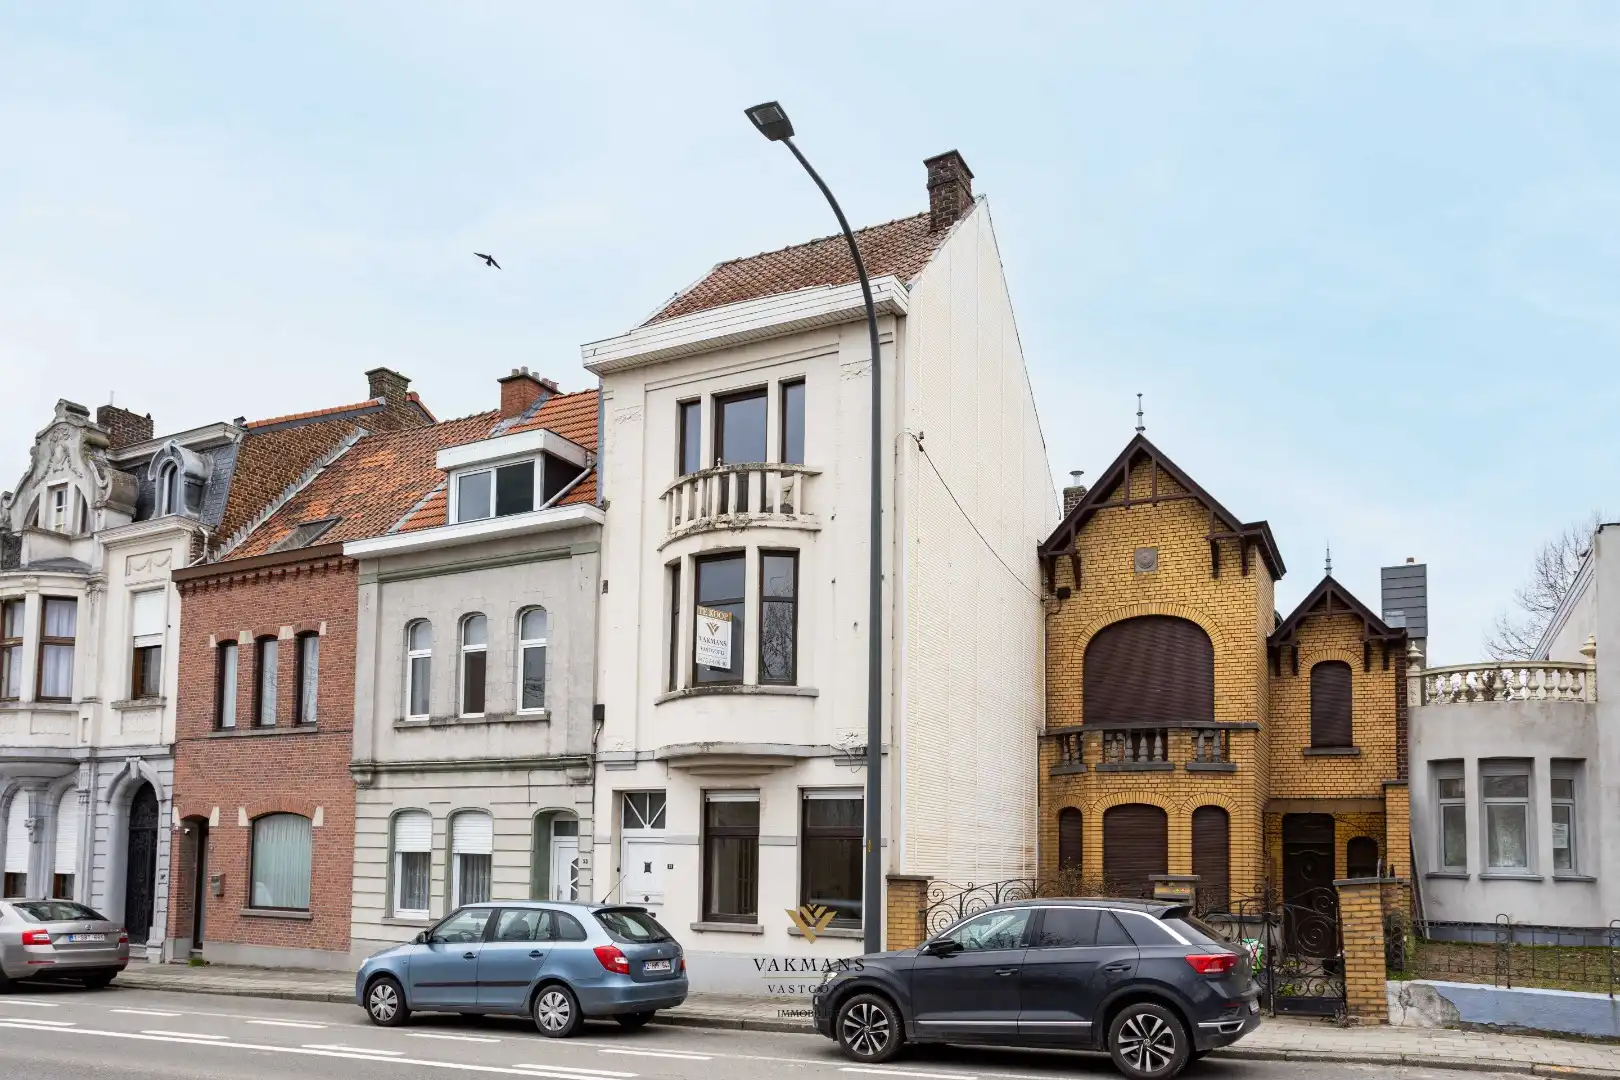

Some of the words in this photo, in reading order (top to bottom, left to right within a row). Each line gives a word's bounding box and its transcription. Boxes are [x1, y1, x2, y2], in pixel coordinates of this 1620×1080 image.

[698, 606, 708, 616] TE
[708, 609, 729, 620] KOOP
[698, 636, 728, 647] VAKMANS
